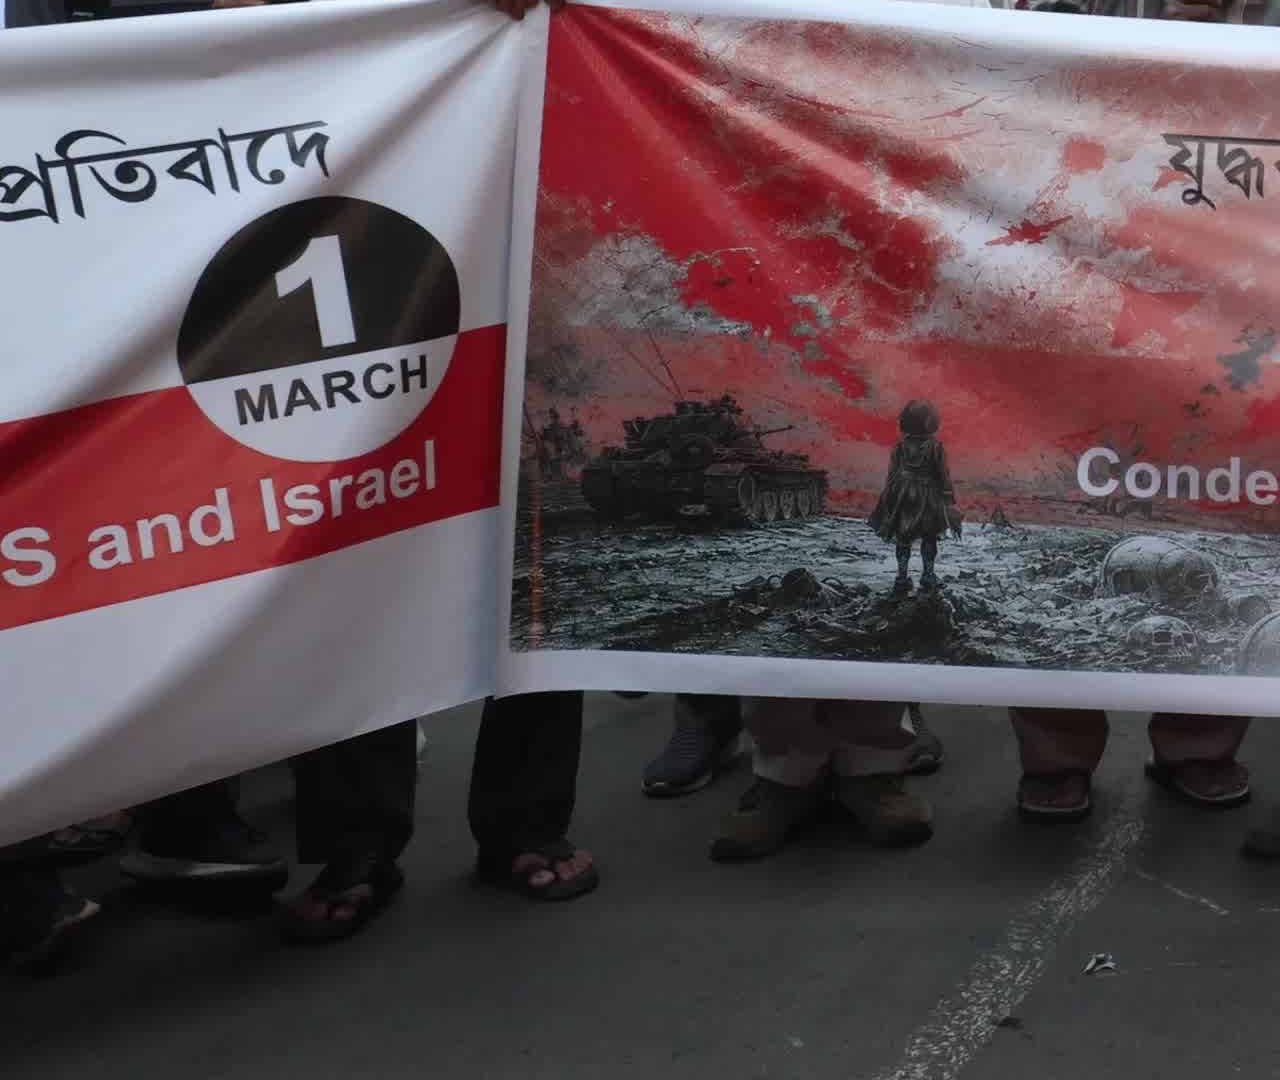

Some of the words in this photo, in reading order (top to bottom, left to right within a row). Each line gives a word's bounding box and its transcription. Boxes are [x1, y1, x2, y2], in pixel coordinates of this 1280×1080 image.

[275, 234, 358, 348] 1
[235, 355, 428, 425] MARCH
[1, 526, 57, 587] S
[88, 487, 236, 570] and
[260, 440, 436, 533] Israel
